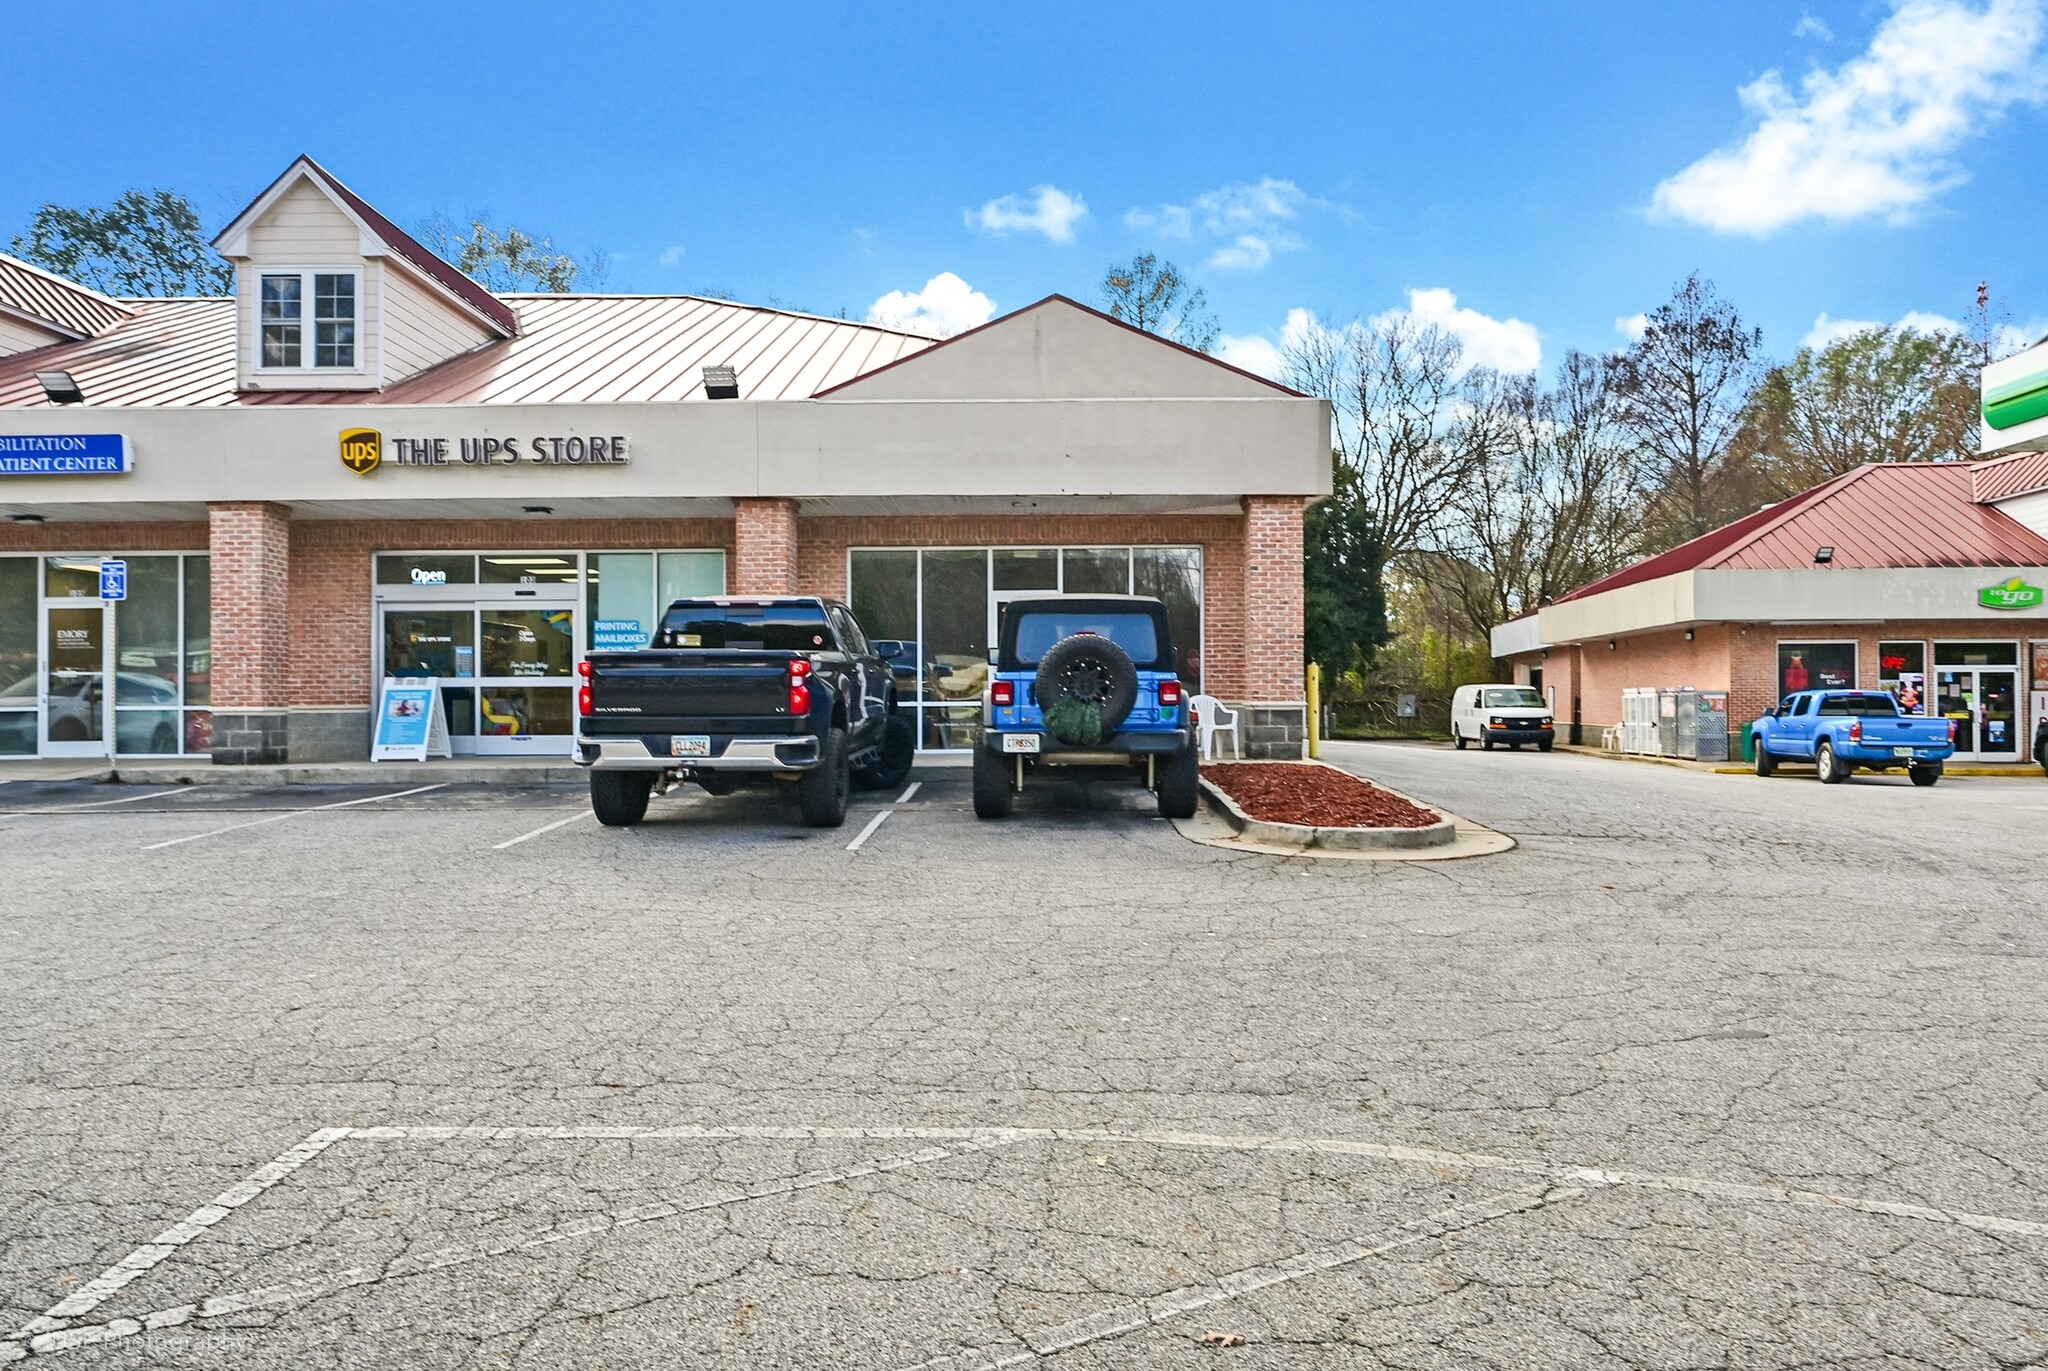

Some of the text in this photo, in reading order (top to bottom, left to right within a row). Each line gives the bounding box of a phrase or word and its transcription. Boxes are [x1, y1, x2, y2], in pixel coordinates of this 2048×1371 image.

[342, 441, 377, 467] ups
[391, 436, 626, 466] THE UPS STORE
[53, 457, 118, 470] CENTER
[410, 568, 446, 584] Open
[2001, 590, 2034, 604] go
[594, 621, 638, 631] PRINTING
[56, 630, 89, 638] EMORY
[594, 633, 647, 643] MAILBOXES
